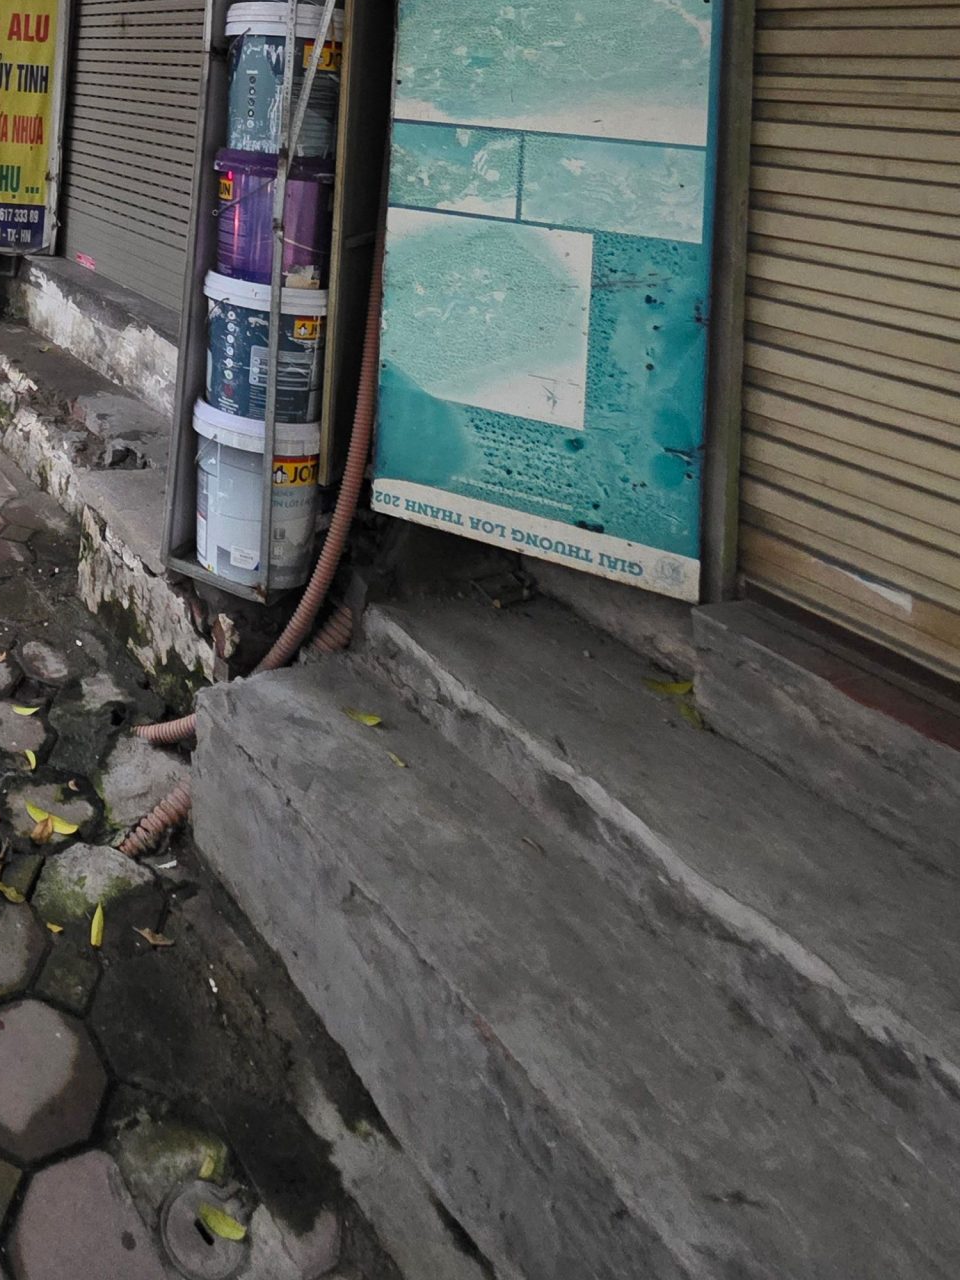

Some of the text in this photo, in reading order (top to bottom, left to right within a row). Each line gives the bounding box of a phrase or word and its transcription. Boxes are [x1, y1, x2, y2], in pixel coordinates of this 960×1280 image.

[7, 13, 50, 43] ALU
[17, 64, 49, 94] TINH
[12, 114, 43, 151] NHỰA
[14, 209, 28, 223] 333
[374, 489, 401, 508] 202
[469, 516, 507, 539] LOA
